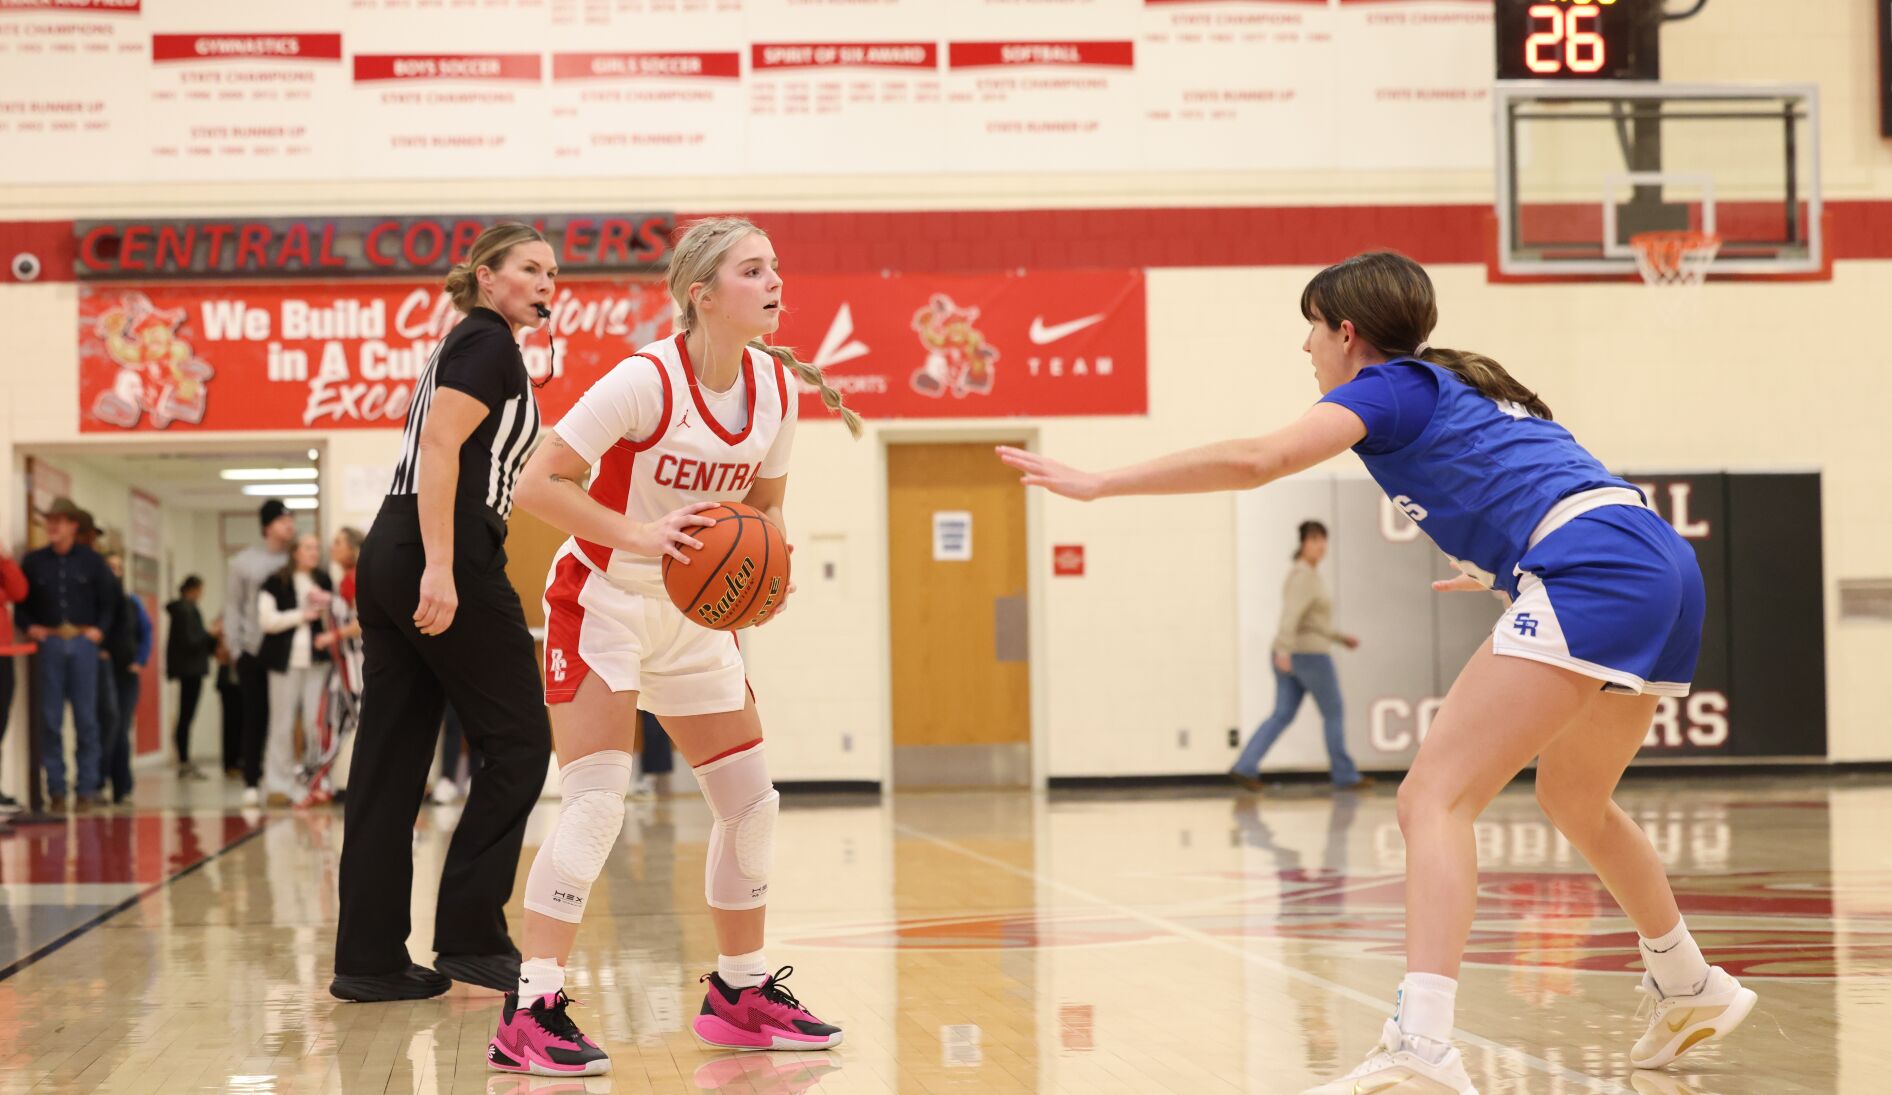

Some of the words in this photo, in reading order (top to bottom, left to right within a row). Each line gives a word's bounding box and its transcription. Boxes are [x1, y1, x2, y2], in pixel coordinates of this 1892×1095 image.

[194, 38, 300, 55] GYMNASTICS
[1525, 4, 1605, 73] 26
[393, 59, 436, 76] BOYS
[438, 59, 500, 75] SOCCER
[591, 57, 638, 74] GIRLS
[639, 56, 701, 73] SOCCER
[764, 46, 813, 64] SPIRIT
[814, 46, 836, 64] OF
[867, 46, 926, 63] AWARD
[1001, 45, 1081, 62] SOFTBALL
[80, 222, 346, 271] CENTRAL
[364, 217, 666, 267] COBERS
[201, 299, 271, 341] We
[280, 298, 387, 340] Build
[267, 341, 308, 381] in
[318, 341, 349, 380] A
[1027, 356, 1113, 377] TEAM
[654, 454, 762, 492] CENTRA
[697, 556, 755, 625] Baden
